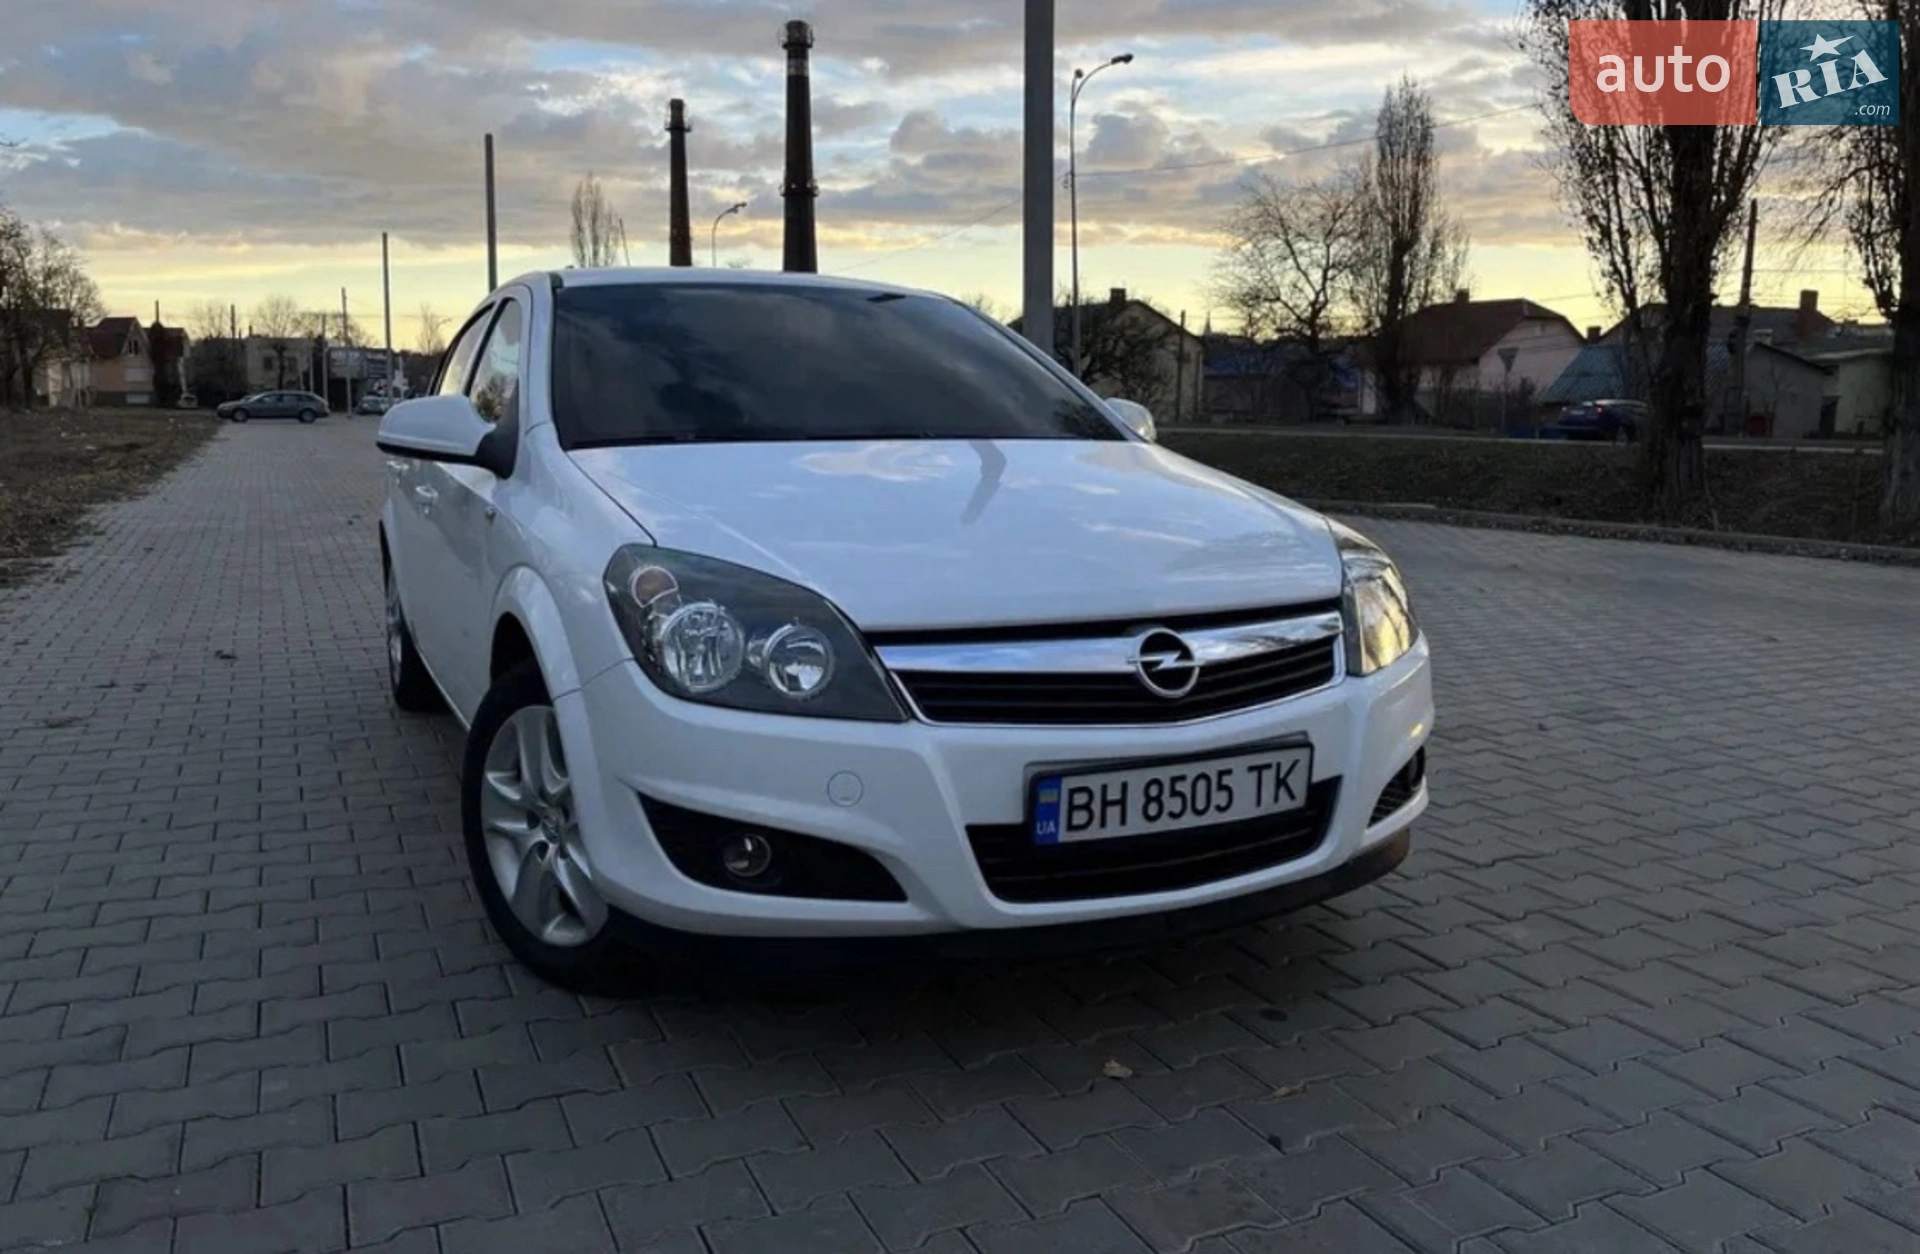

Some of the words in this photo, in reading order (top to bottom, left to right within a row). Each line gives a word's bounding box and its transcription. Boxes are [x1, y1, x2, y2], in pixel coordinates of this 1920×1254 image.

[1065, 781, 1129, 832] BH
[1142, 768, 1234, 822] 8505
[1247, 759, 1301, 808] TK
[1036, 819, 1056, 835] UA
